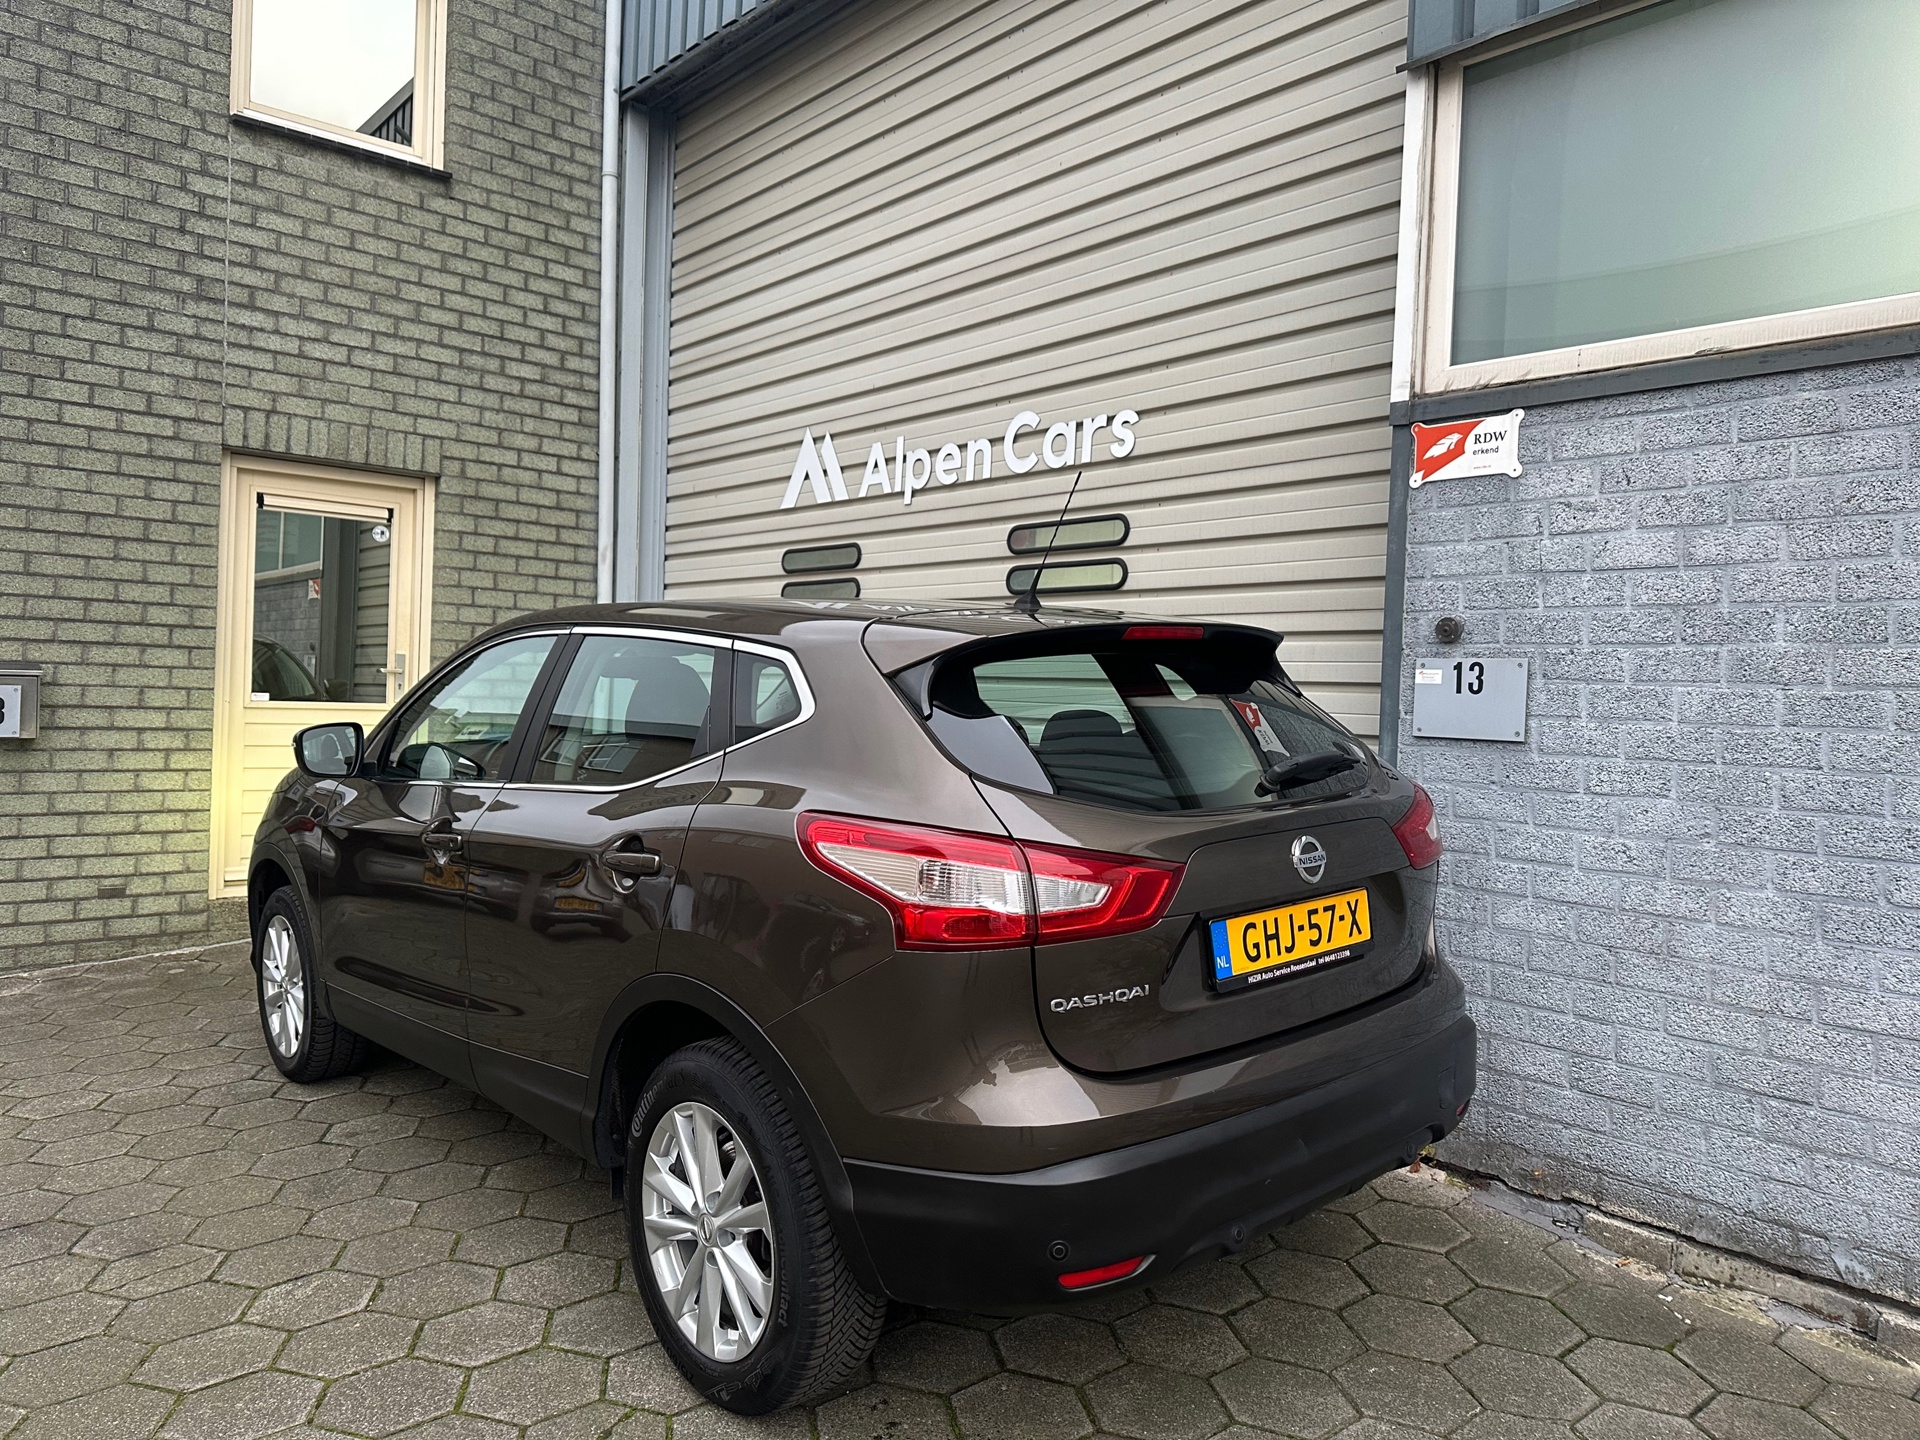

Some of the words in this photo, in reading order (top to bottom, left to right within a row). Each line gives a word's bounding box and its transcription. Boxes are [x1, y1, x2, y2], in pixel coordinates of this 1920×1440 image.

[1473, 430, 1507, 445] RDW
[858, 436, 992, 505] Alpen
[1003, 409, 1140, 474] Cars
[1472, 446, 1499, 455] erkend
[1453, 661, 1484, 695] 13
[1299, 854, 1325, 865] NISSAN
[1242, 898, 1362, 963] GHJ-57-X
[1217, 956, 1229, 969] NL
[1274, 966, 1290, 977] Service
[1050, 984, 1150, 1013] QASHQAI
